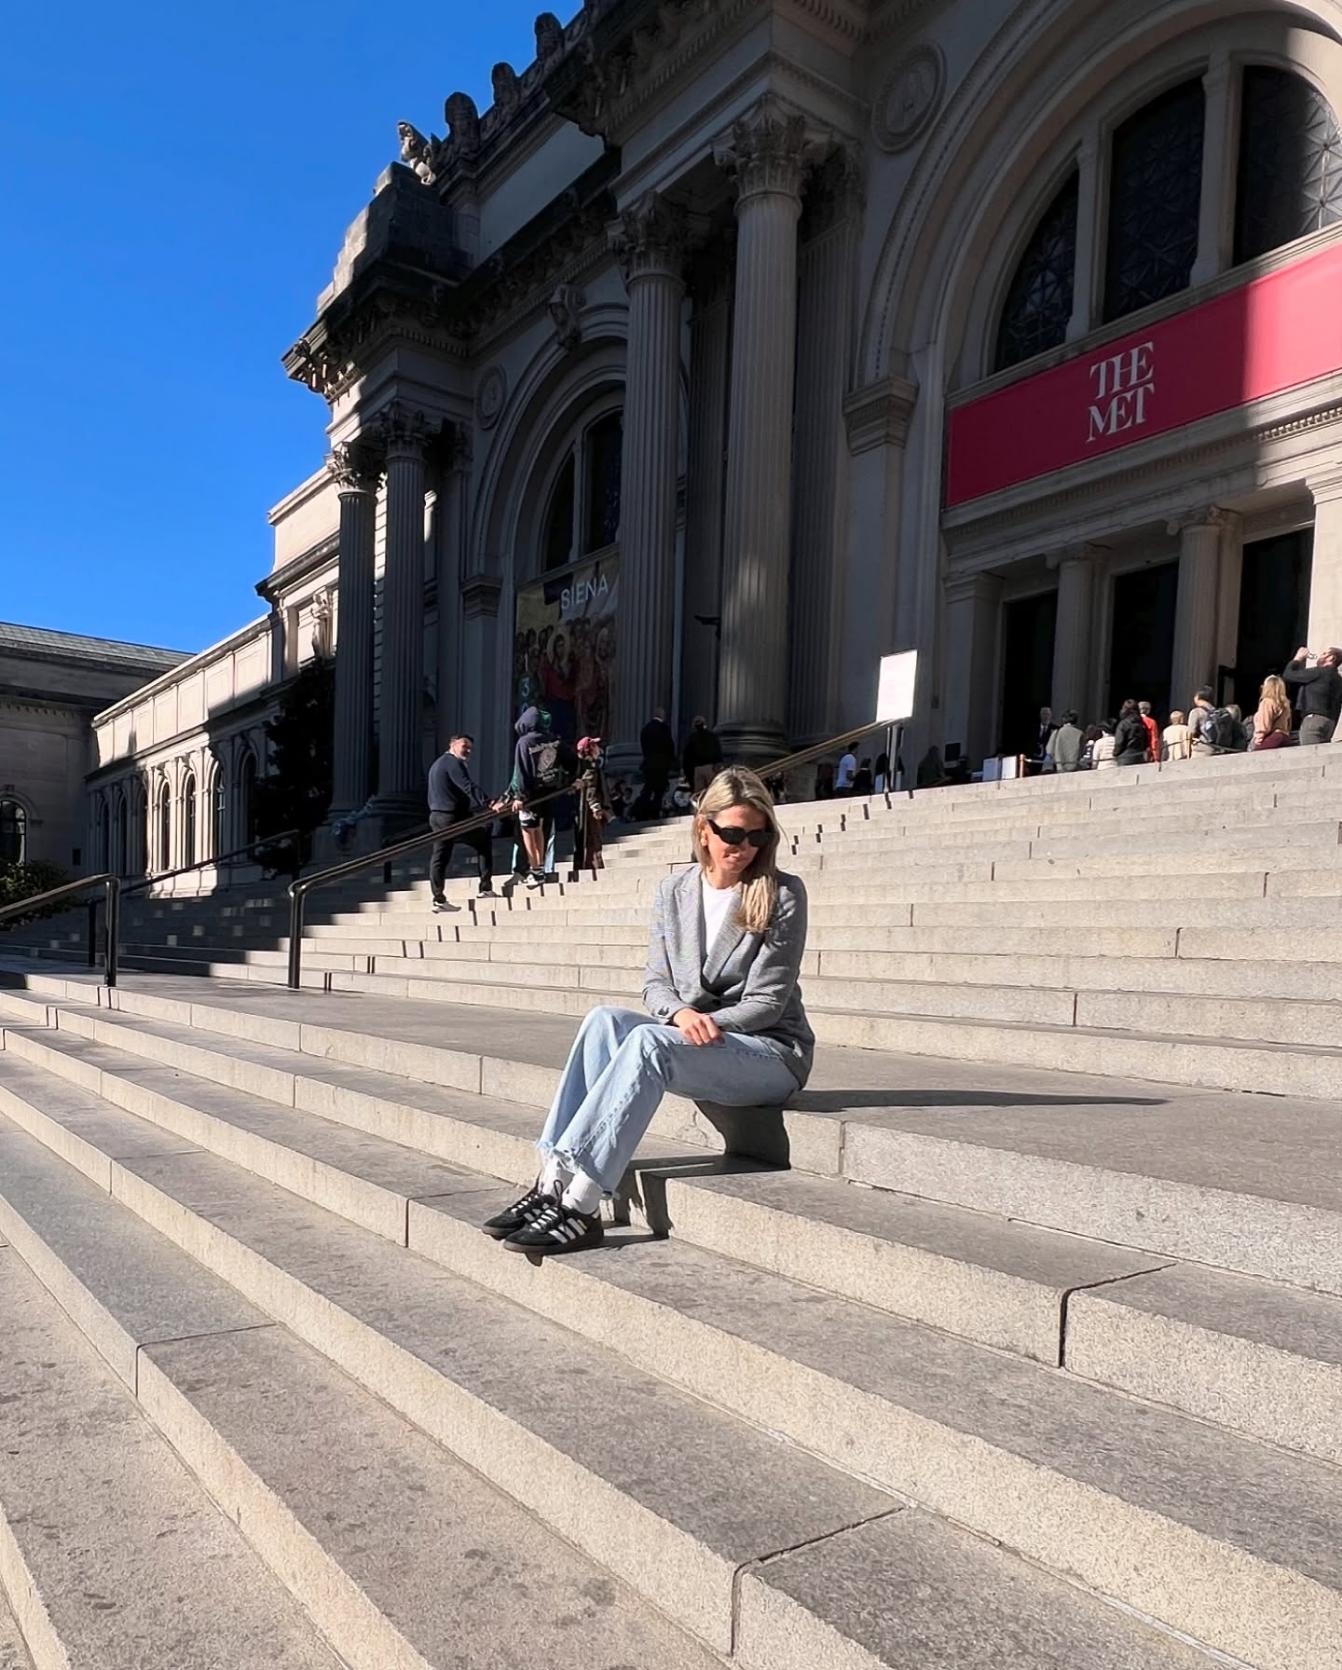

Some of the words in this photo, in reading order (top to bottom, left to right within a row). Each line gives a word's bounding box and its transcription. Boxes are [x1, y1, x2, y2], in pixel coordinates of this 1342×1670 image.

[1089, 341, 1154, 401] THE
[1086, 382, 1155, 443] MET
[560, 573, 609, 610] SIENA
